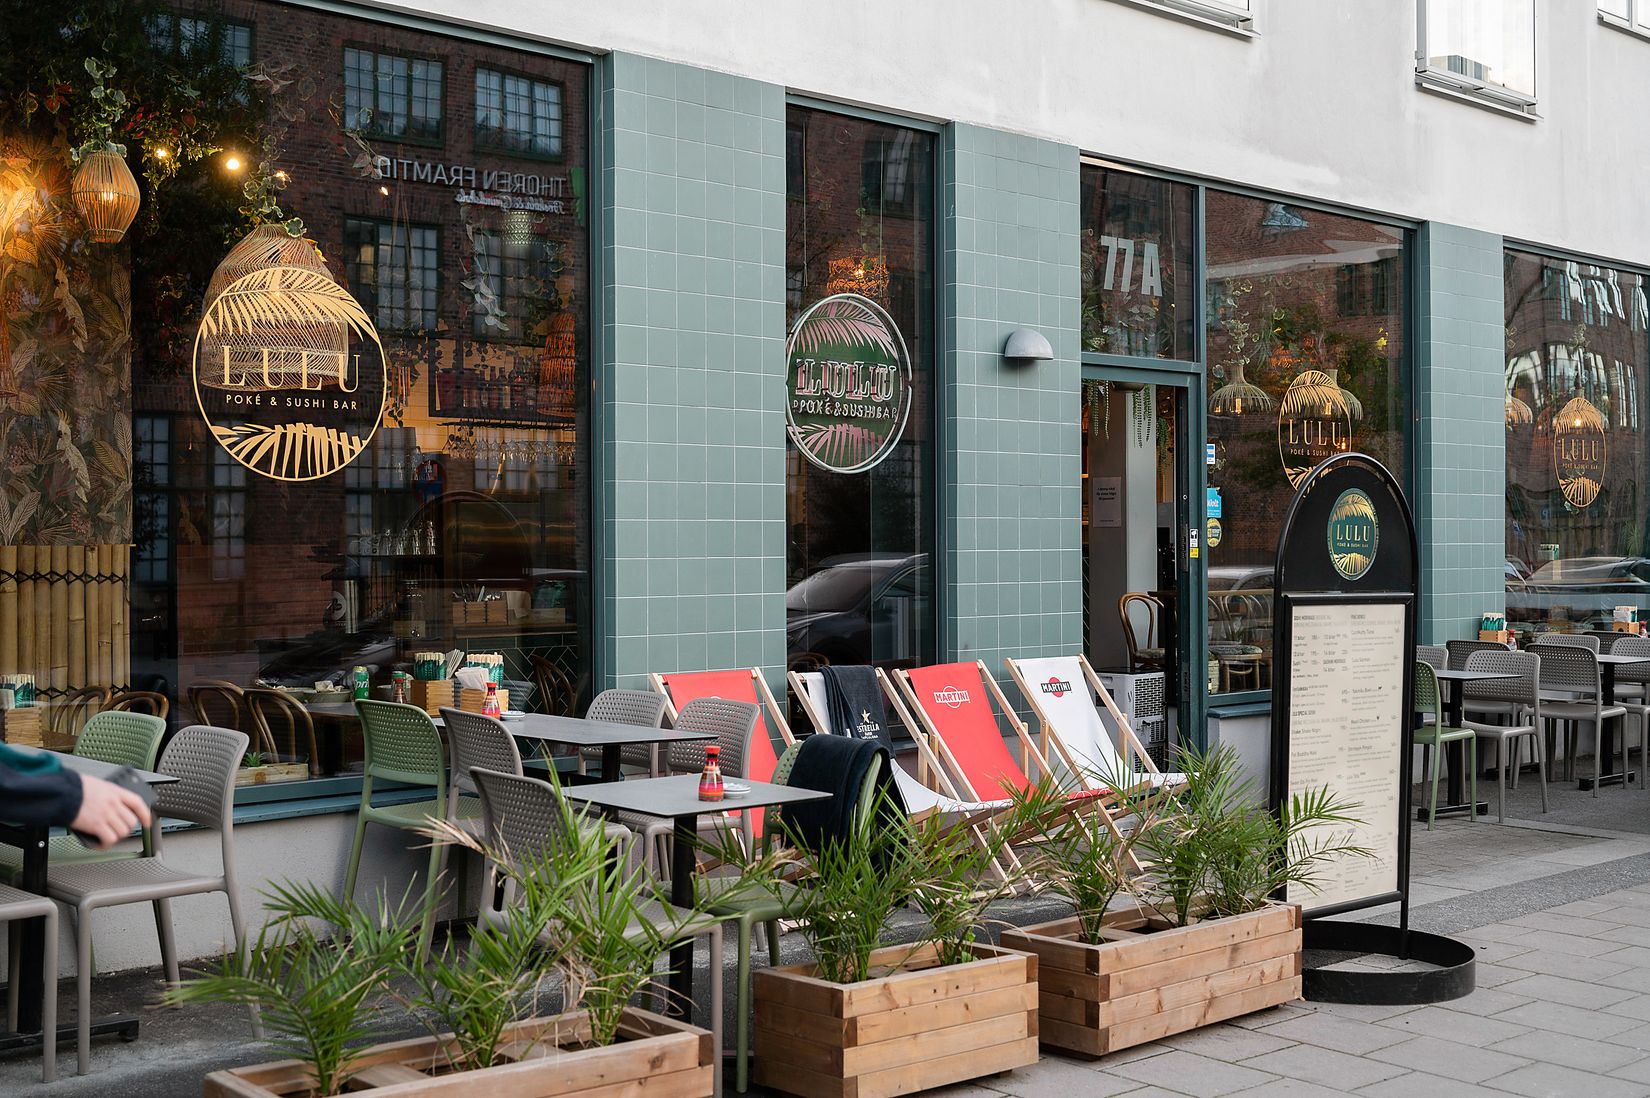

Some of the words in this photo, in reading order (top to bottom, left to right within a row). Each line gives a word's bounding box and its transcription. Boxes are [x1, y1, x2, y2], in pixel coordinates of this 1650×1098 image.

[222, 345, 360, 393] LULU
[796, 359, 897, 402] LULU
[226, 394, 261, 406] POKÉ
[270, 396, 278, 406] &
[286, 398, 325, 409] SUSHI
[333, 400, 357, 410] BAR
[1288, 418, 1342, 447] LULU
[1561, 438, 1599, 461] LULU
[1337, 525, 1370, 541] LULU
[935, 691, 970, 702] MARTINI
[1041, 682, 1072, 692] MARTINI
